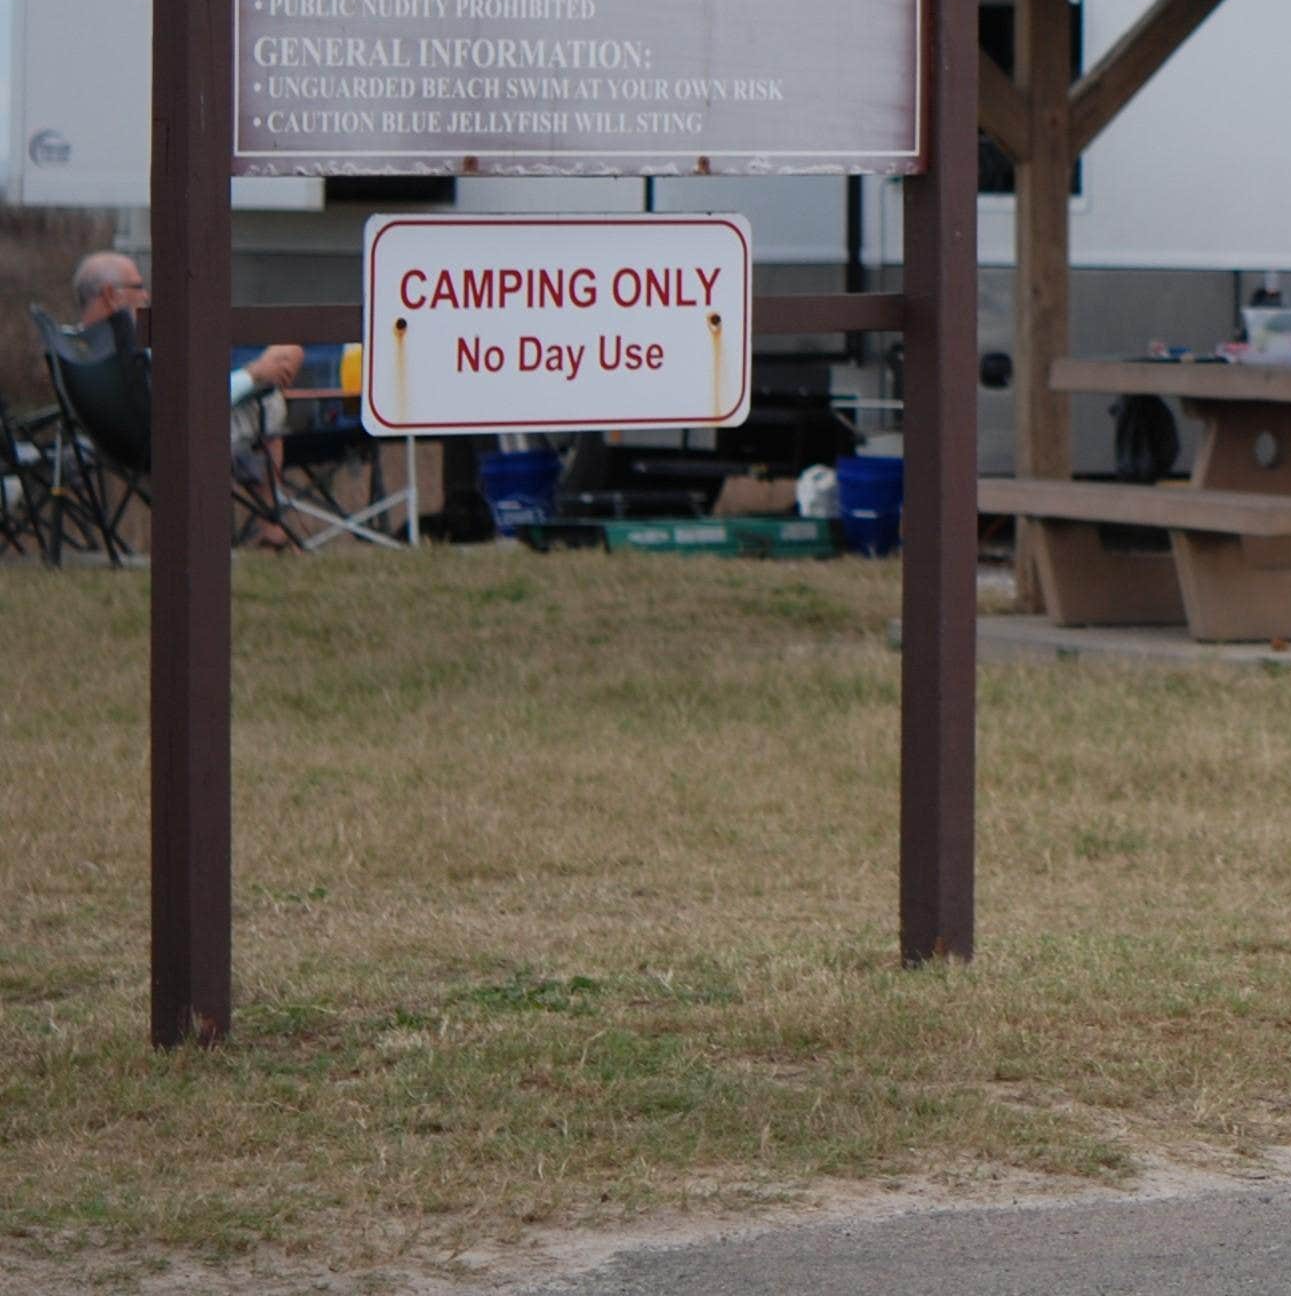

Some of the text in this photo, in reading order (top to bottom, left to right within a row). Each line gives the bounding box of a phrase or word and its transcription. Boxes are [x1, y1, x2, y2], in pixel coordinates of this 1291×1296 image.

[254, 36, 652, 69] GENERAL INFORMATION:
[268, 76, 784, 101] UNGUARDED BEACH SWIM AT YOUR OWN RISK
[267, 111, 703, 134] CAUTION BLUE JELLYFISH WILL STING
[400, 267, 722, 310] CAMPING ONLY
[457, 334, 665, 381] No Day Use
